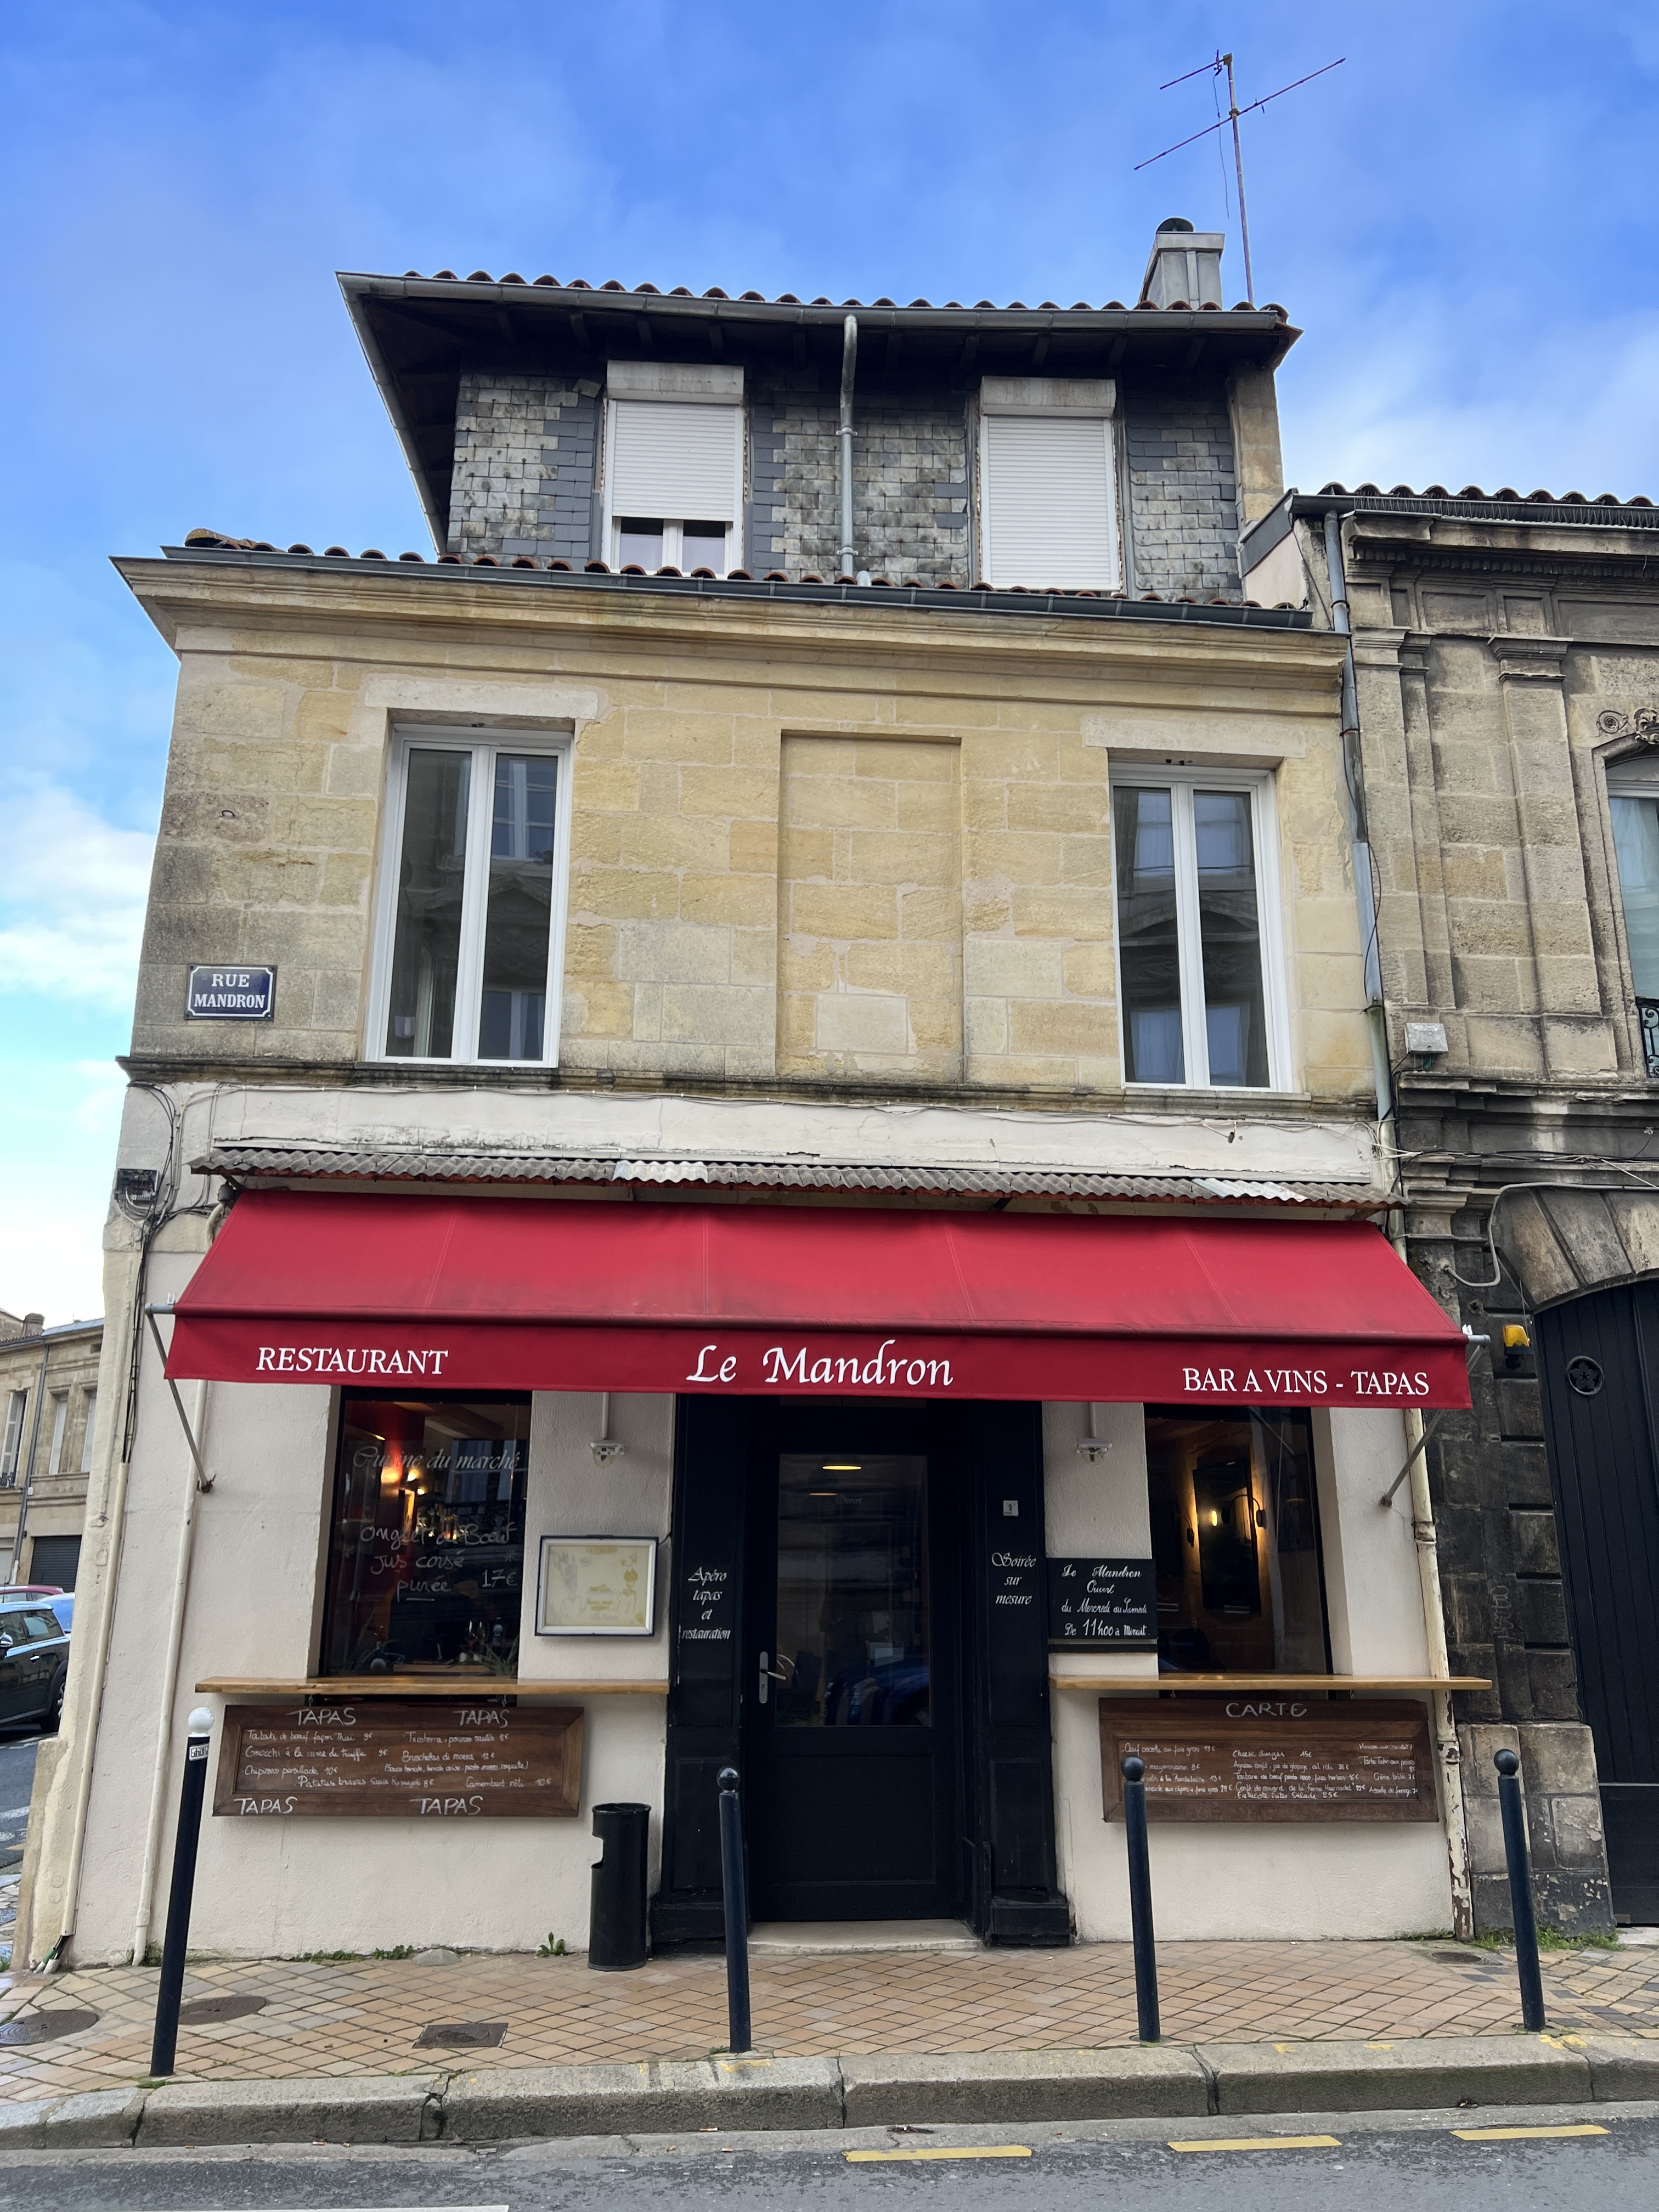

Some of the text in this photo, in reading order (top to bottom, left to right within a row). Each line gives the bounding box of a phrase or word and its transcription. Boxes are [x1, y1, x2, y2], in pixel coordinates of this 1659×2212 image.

[211, 973, 250, 988] RUE
[194, 994, 266, 1008] MANDRON
[256, 1347, 448, 1374] RESTAURANT
[686, 1339, 953, 1386] Le Mandron
[1182, 1368, 1237, 1392] BAR
[1242, 1369, 1263, 1392] A
[1263, 1369, 1328, 1394] VINS
[1350, 1370, 1429, 1396] TAPAS
[427, 1448, 450, 1469] du
[456, 1448, 521, 1470] marché
[415, 1549, 465, 1570] corsé
[991, 1552, 1036, 1567] Soirée
[482, 1568, 518, 1588] 17€
[687, 1566, 727, 1587] Apéro
[1003, 1576, 1022, 1585] sur
[1062, 1564, 1142, 1578] Le Mandron
[397, 1575, 452, 1602] purée
[1086, 1579, 1115, 1594] Ouvert
[995, 1594, 1032, 1605] mesure
[1061, 1598, 1071, 1612] du
[1077, 1597, 1110, 1613] Mercredi
[1122, 1596, 1147, 1613] Samedi
[681, 1627, 731, 1639] restauration
[1064, 1623, 1077, 1636] De
[1082, 1618, 1114, 1637] 11h00
[1115, 1627, 1120, 1636] à
[286, 1707, 357, 1726] TAPAS
[453, 1709, 510, 1728] TAPAS
[1226, 1702, 1307, 1718] CARTE
[1232, 1750, 1256, 1758] Cheese
[1259, 1750, 1285, 1760] Burger
[233, 1796, 298, 1815] TAPAS
[409, 1795, 483, 1815] TAPAS
